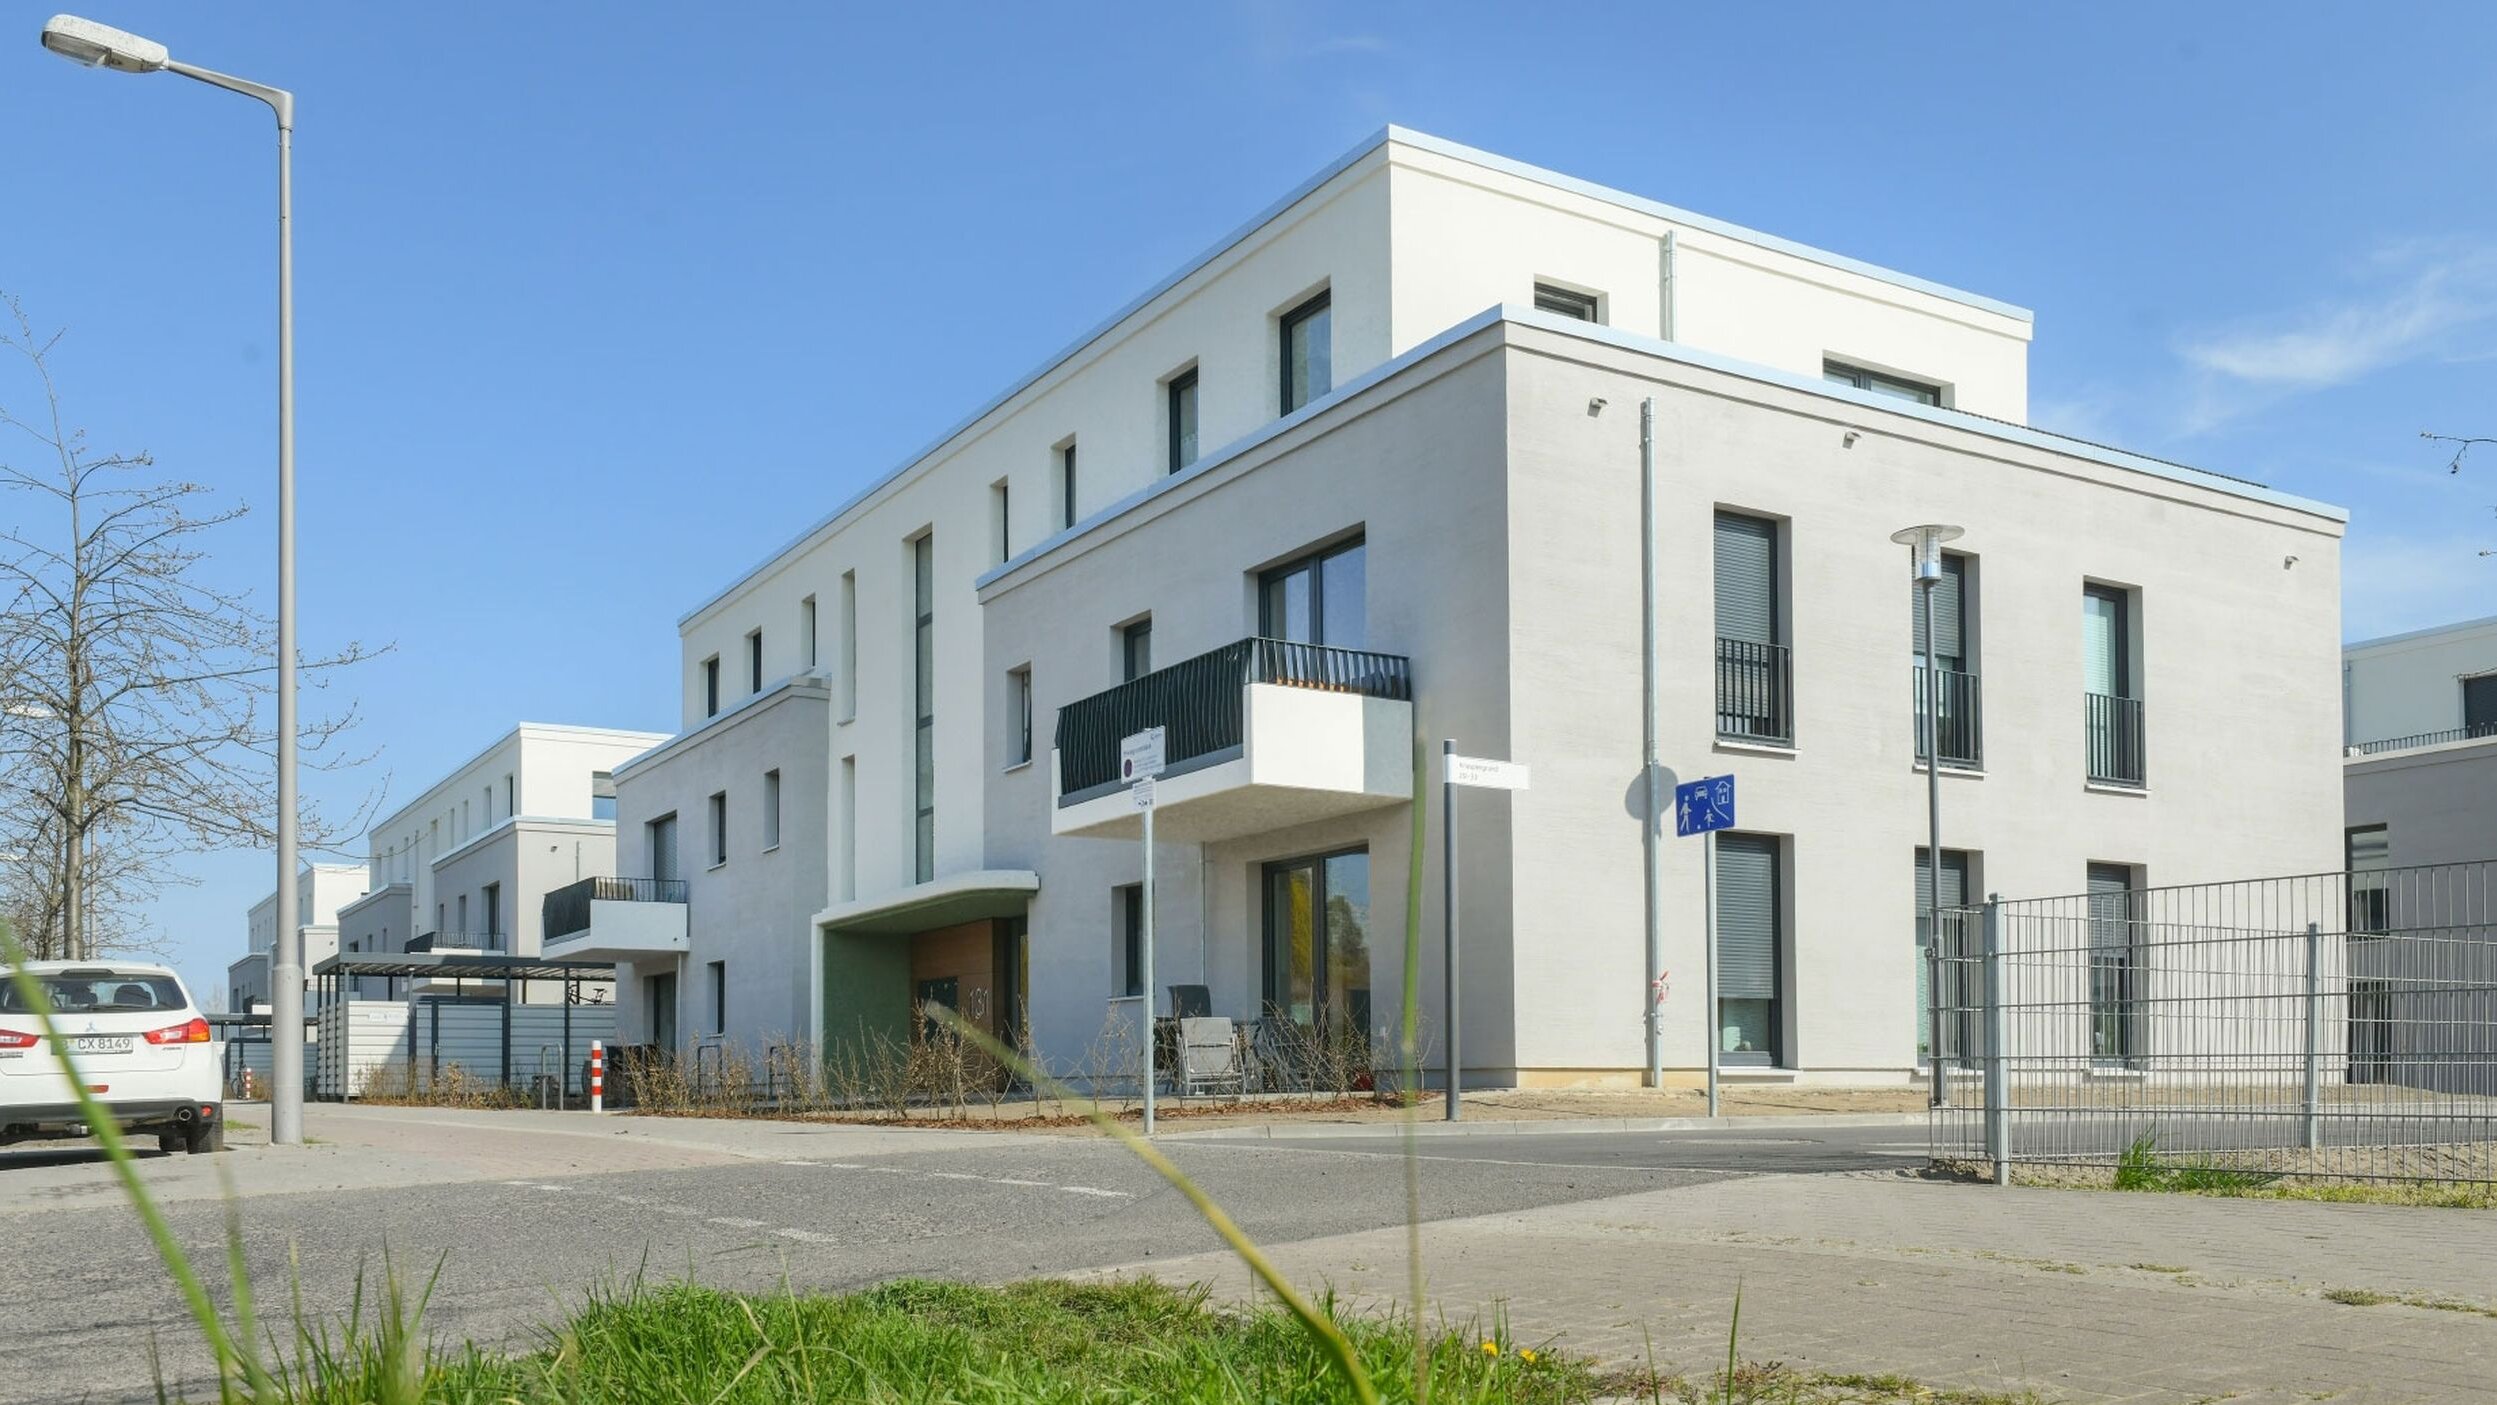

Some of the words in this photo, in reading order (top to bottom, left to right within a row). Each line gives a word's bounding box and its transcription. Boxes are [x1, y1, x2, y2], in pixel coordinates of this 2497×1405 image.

[969, 987, 989, 1020] 131
[78, 1038, 95, 1050] CX
[98, 1037, 130, 1049] 8149
